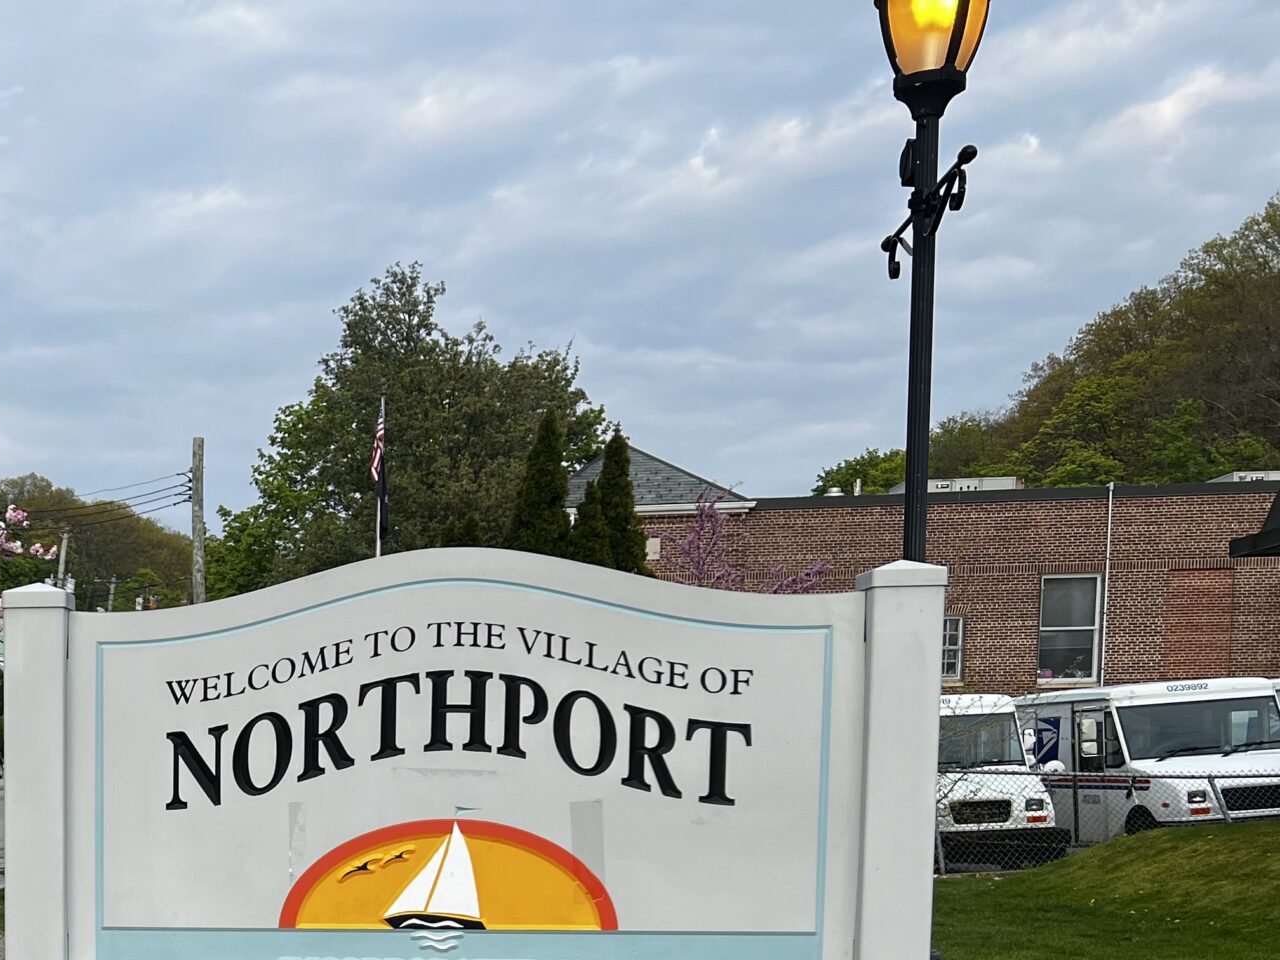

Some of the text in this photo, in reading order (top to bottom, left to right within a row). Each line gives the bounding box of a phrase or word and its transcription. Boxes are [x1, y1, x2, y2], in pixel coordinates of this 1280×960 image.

[164, 620, 755, 706] WELCOME TO THE VILLAGE OF
[1166, 682, 1209, 693] 0239892
[165, 669, 753, 811] NORTHPORT
